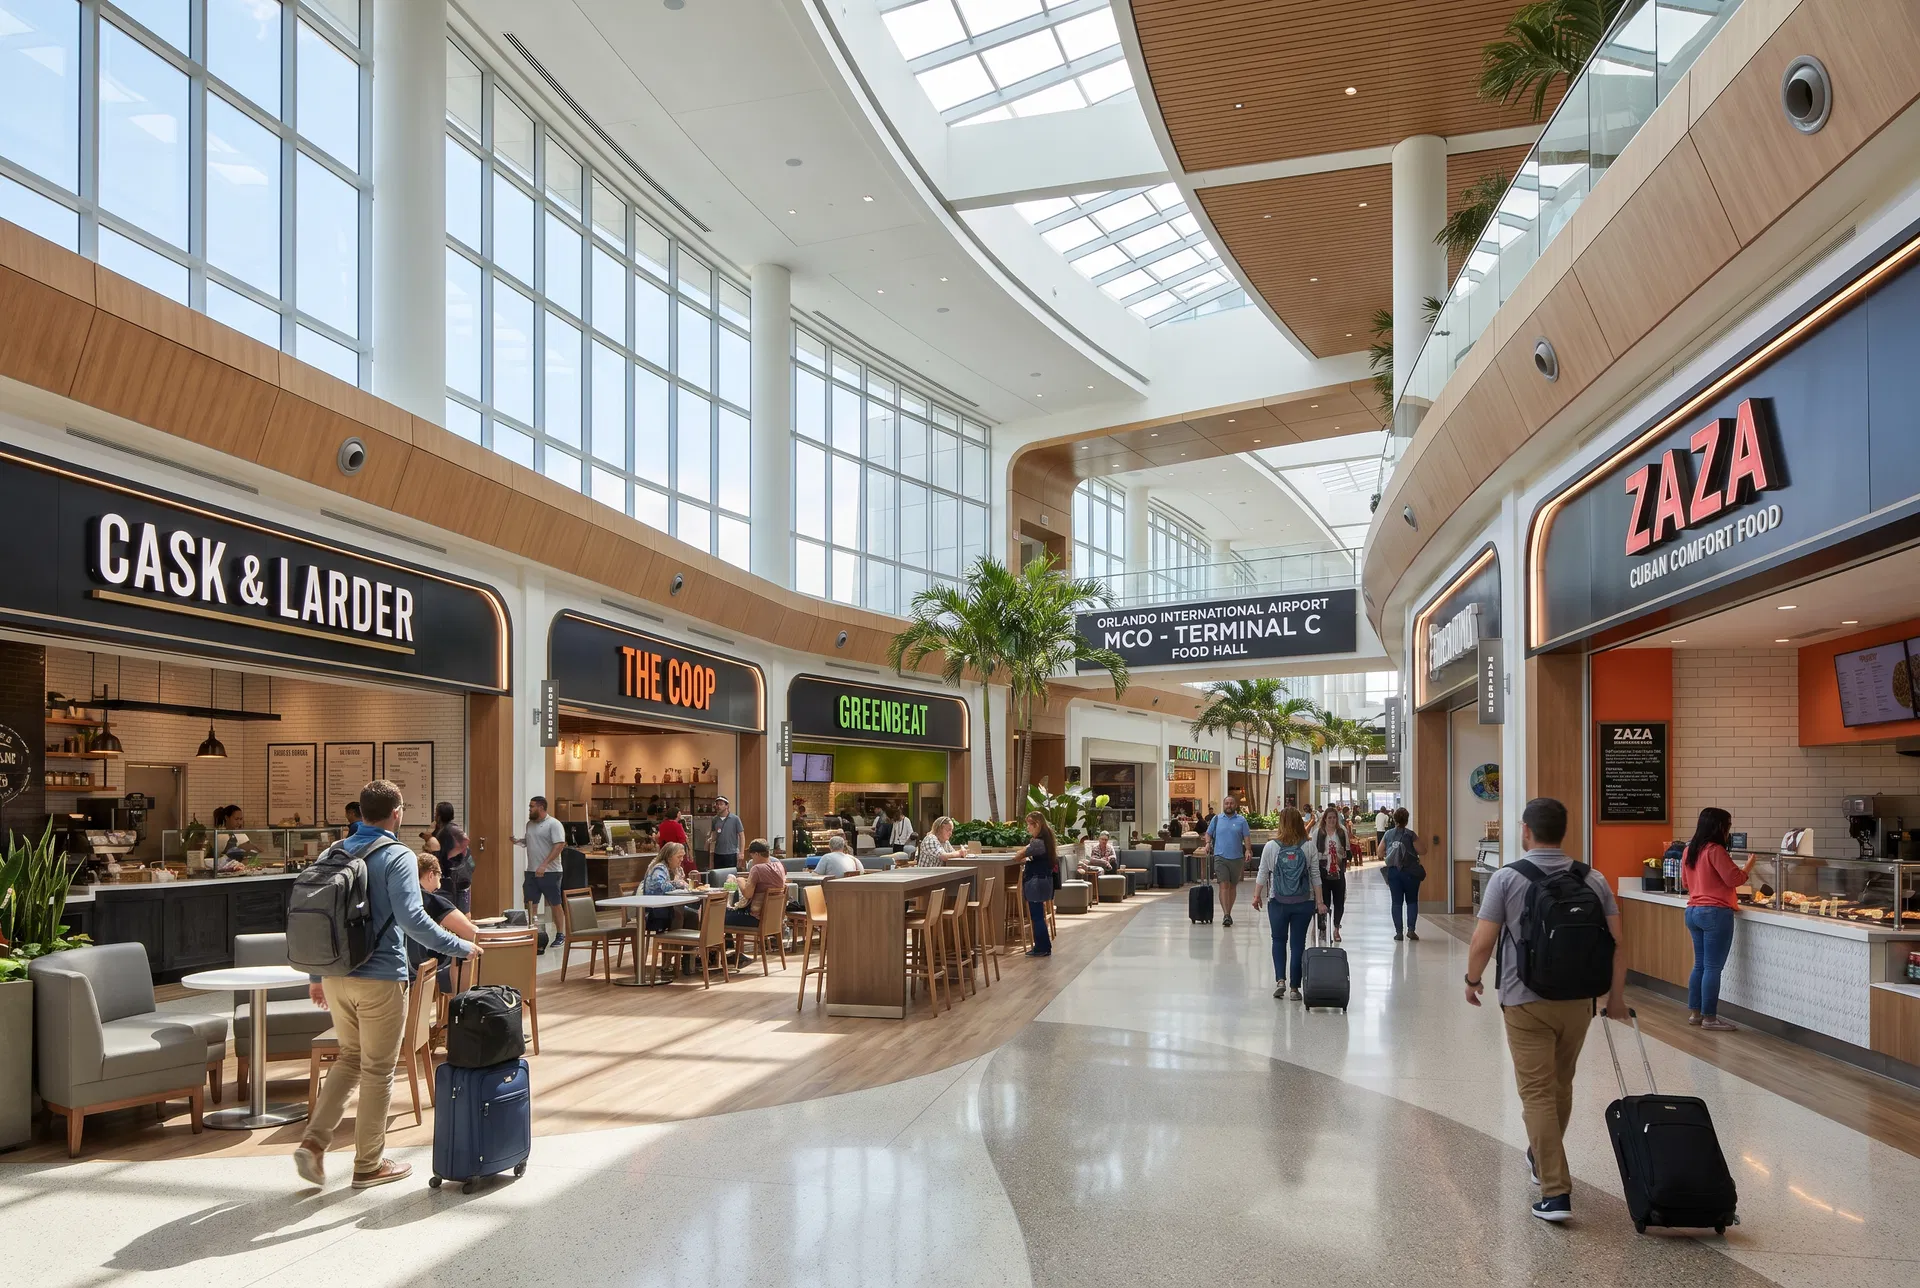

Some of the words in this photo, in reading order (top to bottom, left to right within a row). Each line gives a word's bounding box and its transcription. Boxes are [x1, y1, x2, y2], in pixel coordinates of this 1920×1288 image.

[1625, 398, 1768, 556] ZAZA
[1629, 554, 1670, 589] CUBAN
[1670, 523, 1735, 572] COMFORT
[1737, 504, 1783, 543] FOOD
[100, 513, 227, 604] CASK
[239, 554, 268, 606] &
[280, 557, 414, 642] LARDER
[1097, 613, 1157, 629] ORLANDO
[1160, 604, 1264, 624] INTERNATIONAL
[1268, 598, 1329, 614] AIRPORT
[1104, 629, 1153, 650] MCO
[1175, 616, 1297, 645] TERMINAL
[1304, 614, 1321, 635] C
[1172, 645, 1210, 659] FOOD
[1213, 643, 1248, 657] HALL
[622, 646, 662, 702] THE
[668, 658, 716, 711] COOP
[839, 695, 928, 736] GREENBEAT
[1613, 728, 1653, 740] ZAZA
